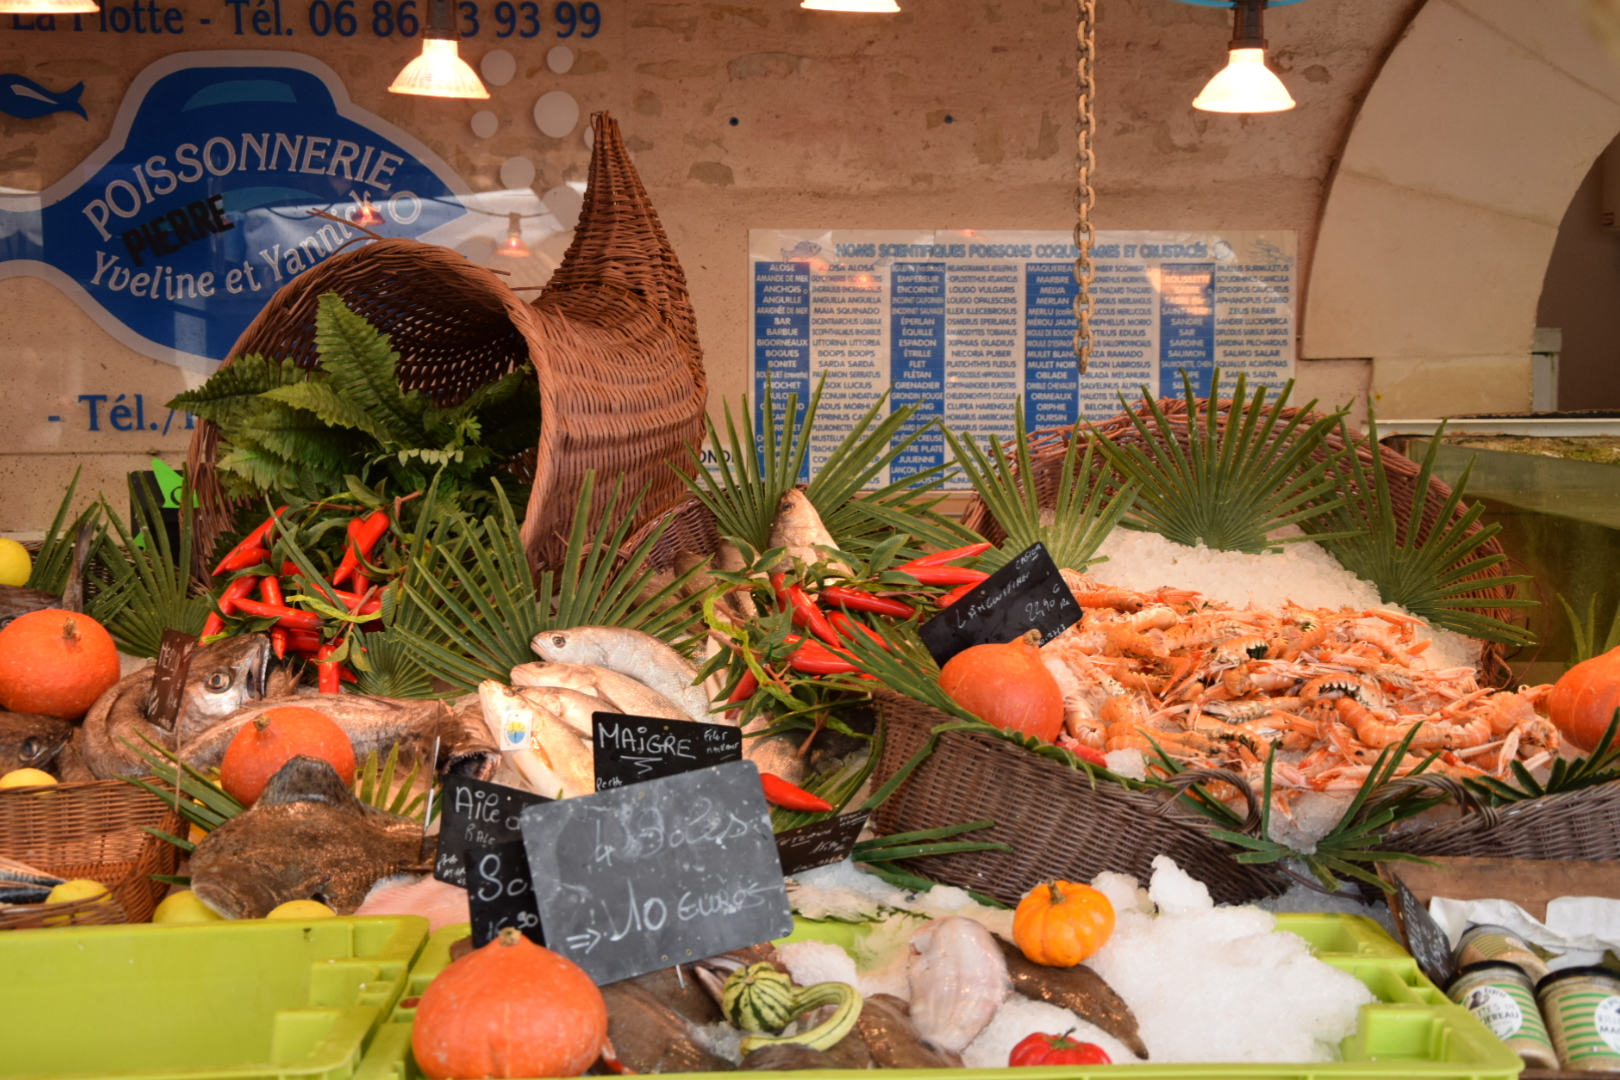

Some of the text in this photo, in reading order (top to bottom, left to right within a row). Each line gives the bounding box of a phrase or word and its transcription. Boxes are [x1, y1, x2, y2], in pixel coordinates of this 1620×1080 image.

[225, 0, 293, 36] Tél.
[308, 0, 358, 37] 06
[372, 0, 420, 37] 86
[494, 1, 540, 38] 93
[555, 1, 602, 38] 99
[82, 132, 404, 242] POISSONNERIE
[90, 188, 383, 301] Yveline et Yannick
[121, 193, 235, 268] PIERRE
[835, 243, 876, 258] NOMS
[878, 243, 966, 258] SCIENTIFIQUES
[968, 243, 1032, 258] POISSONS
[1123, 245, 1137, 258] ET
[1140, 241, 1208, 258] CRUSTACÉS
[1028, 317, 1053, 325] MÉROU
[598, 722, 697, 760] MAIGRE
